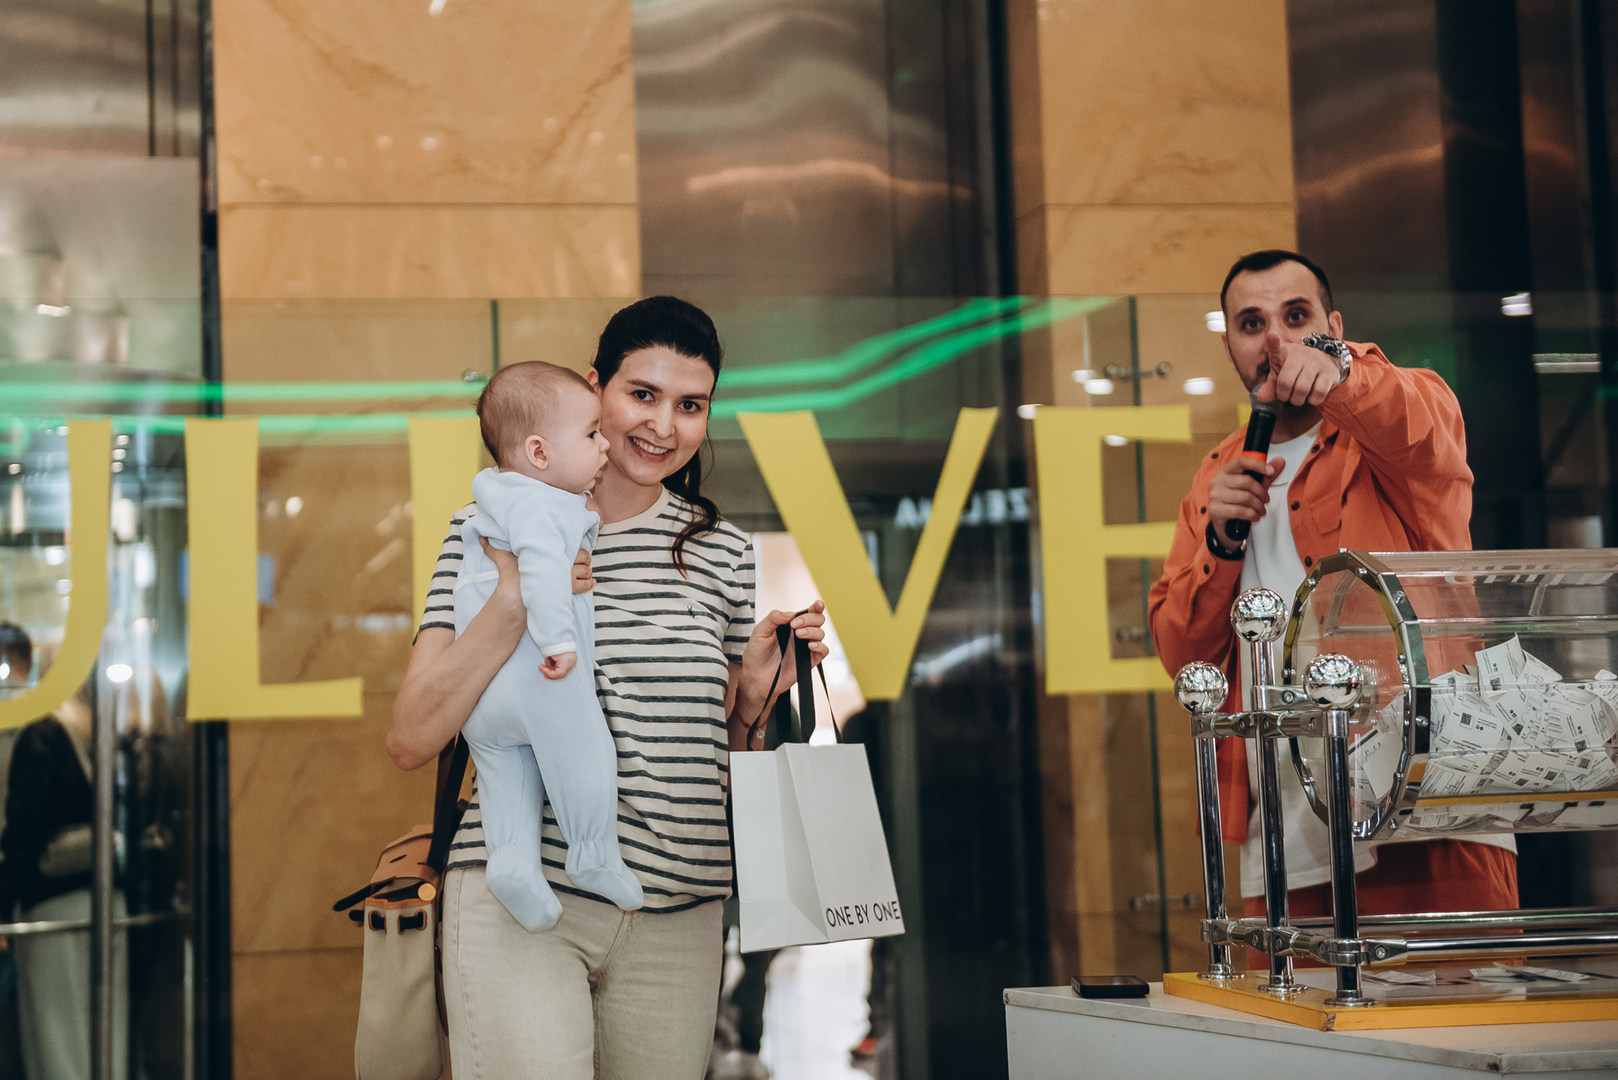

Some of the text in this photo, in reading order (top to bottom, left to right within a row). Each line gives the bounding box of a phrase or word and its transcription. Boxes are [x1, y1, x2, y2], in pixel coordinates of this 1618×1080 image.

[826, 901, 900, 928] ONE BY ONE
